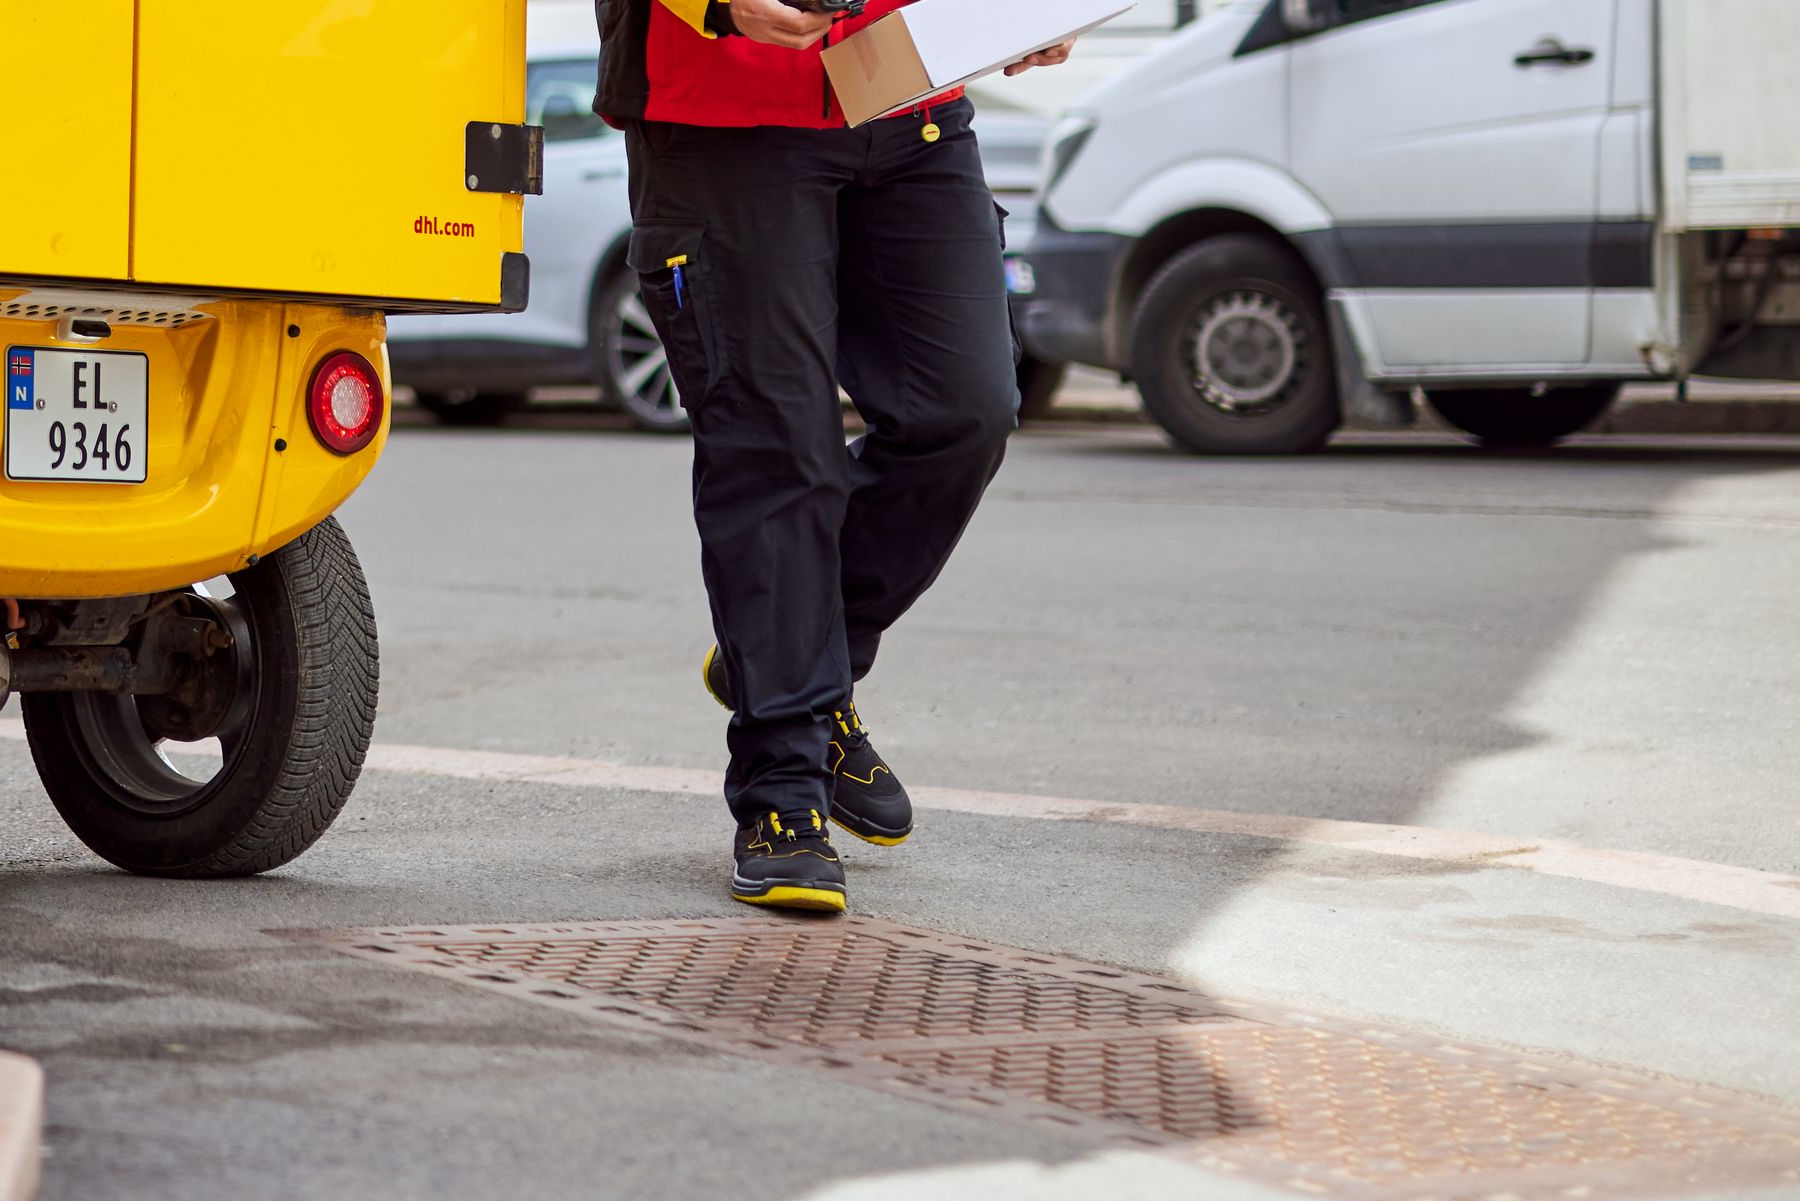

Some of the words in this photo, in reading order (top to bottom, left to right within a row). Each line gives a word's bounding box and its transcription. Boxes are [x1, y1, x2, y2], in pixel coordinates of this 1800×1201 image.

[413, 215, 475, 237] dhl.com
[15, 386, 27, 402] N
[73, 362, 108, 410] EL
[49, 420, 132, 472] 9346
